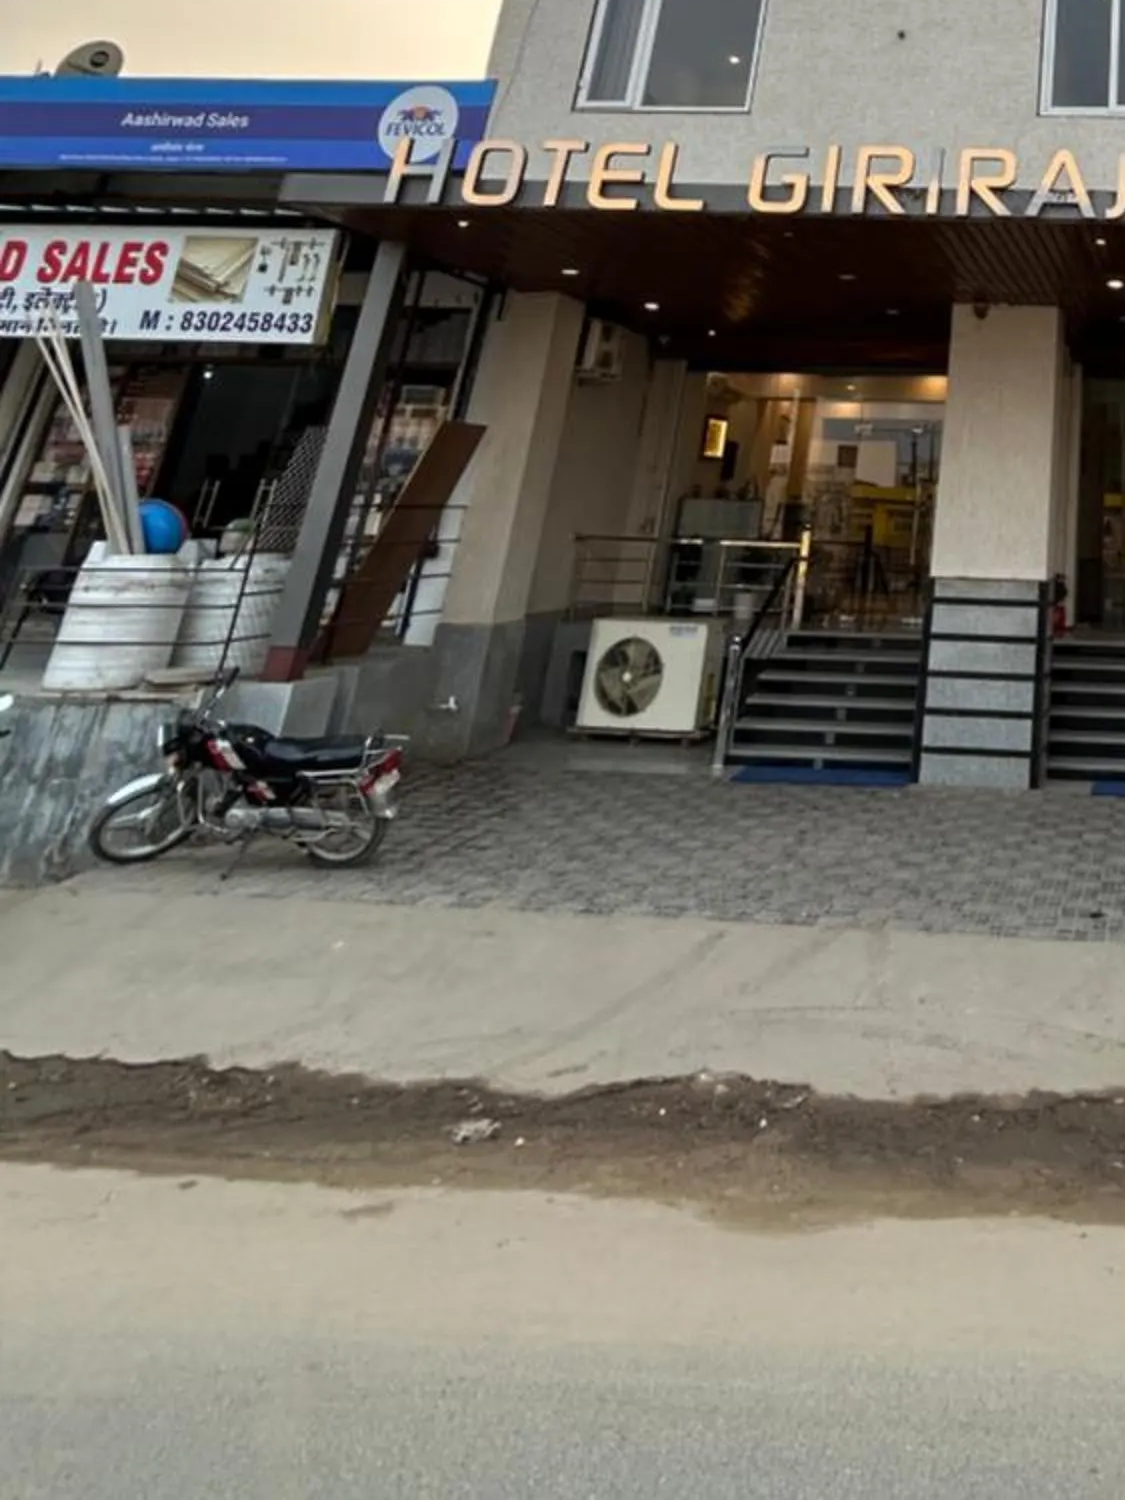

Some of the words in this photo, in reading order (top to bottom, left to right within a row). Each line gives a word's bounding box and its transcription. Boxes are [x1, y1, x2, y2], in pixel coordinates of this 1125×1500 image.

[120, 112, 205, 127] Aashirwad
[206, 112, 249, 128] Sales
[385, 122, 445, 137] FEVICOL
[384, 138, 704, 212] HOTEL
[37, 240, 170, 285] SALES
[180, 310, 313, 333] 8302458433
